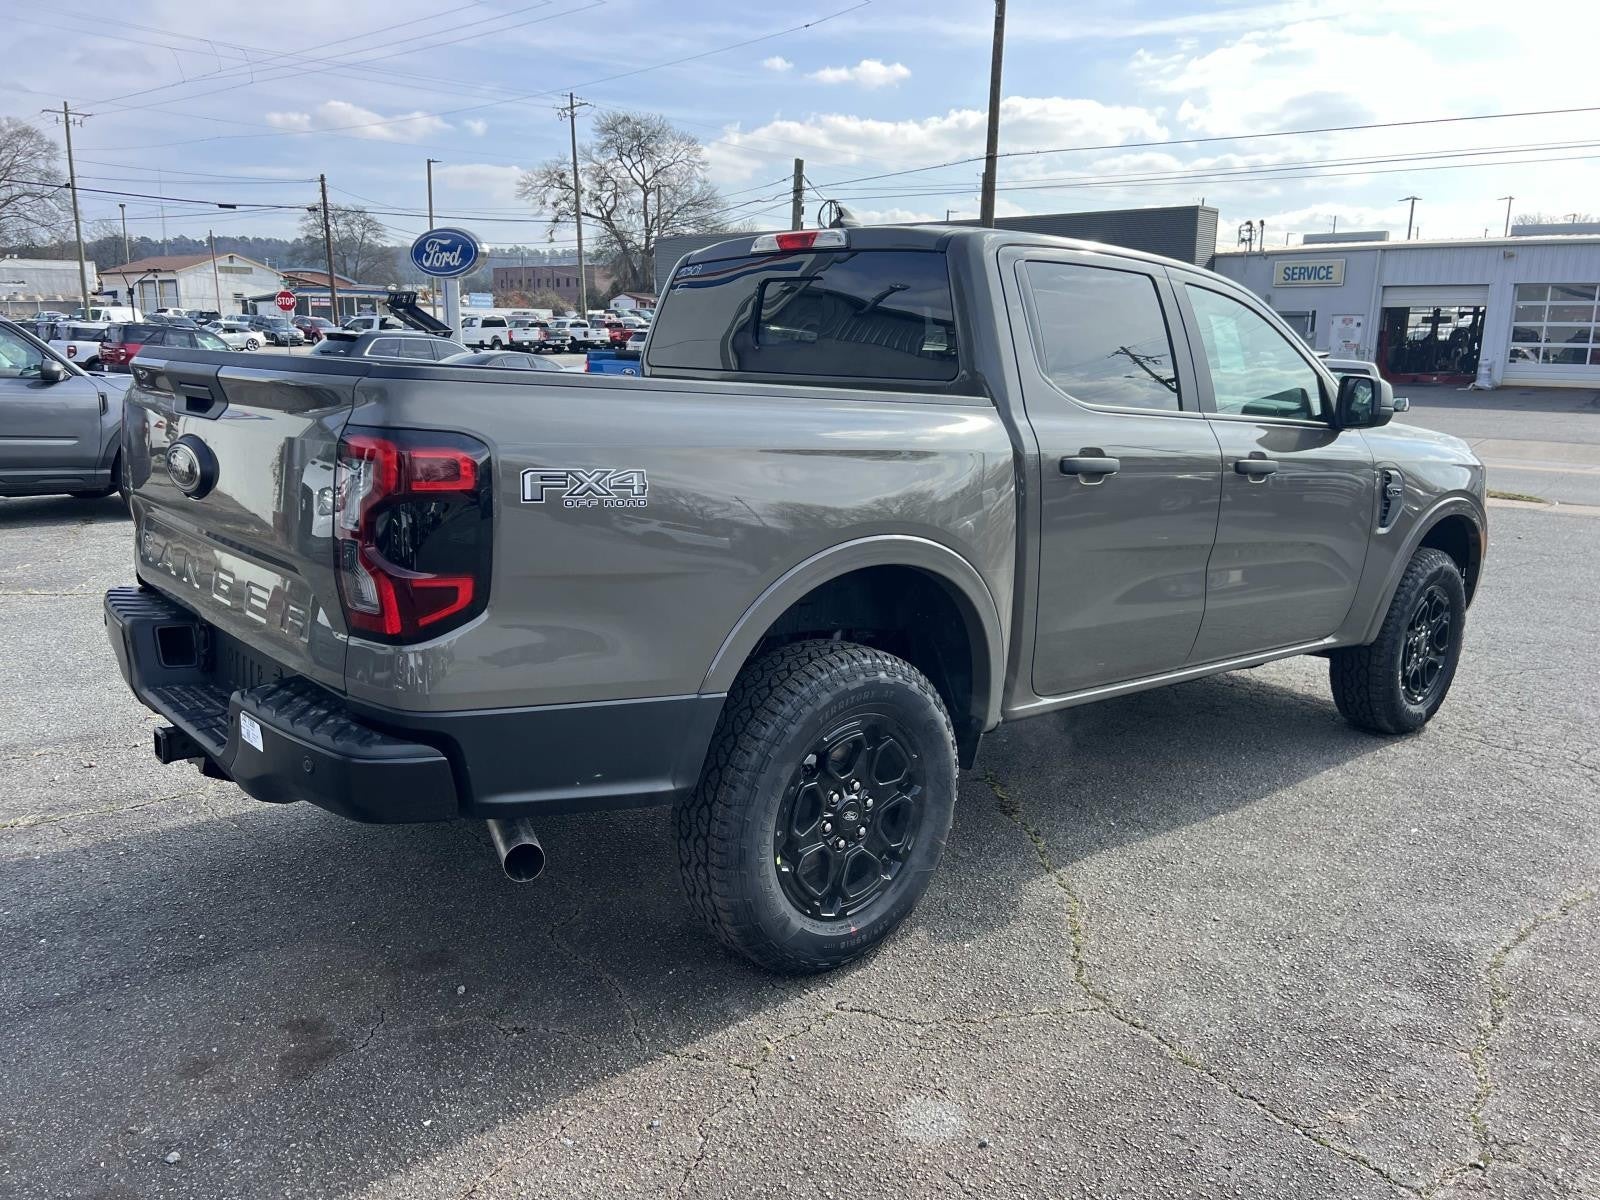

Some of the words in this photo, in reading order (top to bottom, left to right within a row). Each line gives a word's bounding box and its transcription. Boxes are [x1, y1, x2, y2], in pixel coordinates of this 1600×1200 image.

[422, 238, 463, 267] Ford
[1282, 265, 1334, 281] SERVICE
[277, 296, 295, 306] STOP
[520, 467, 649, 503] FX4
[563, 498, 599, 508] OFF
[603, 498, 648, 508] ROAD
[142, 533, 314, 644] RANGER
